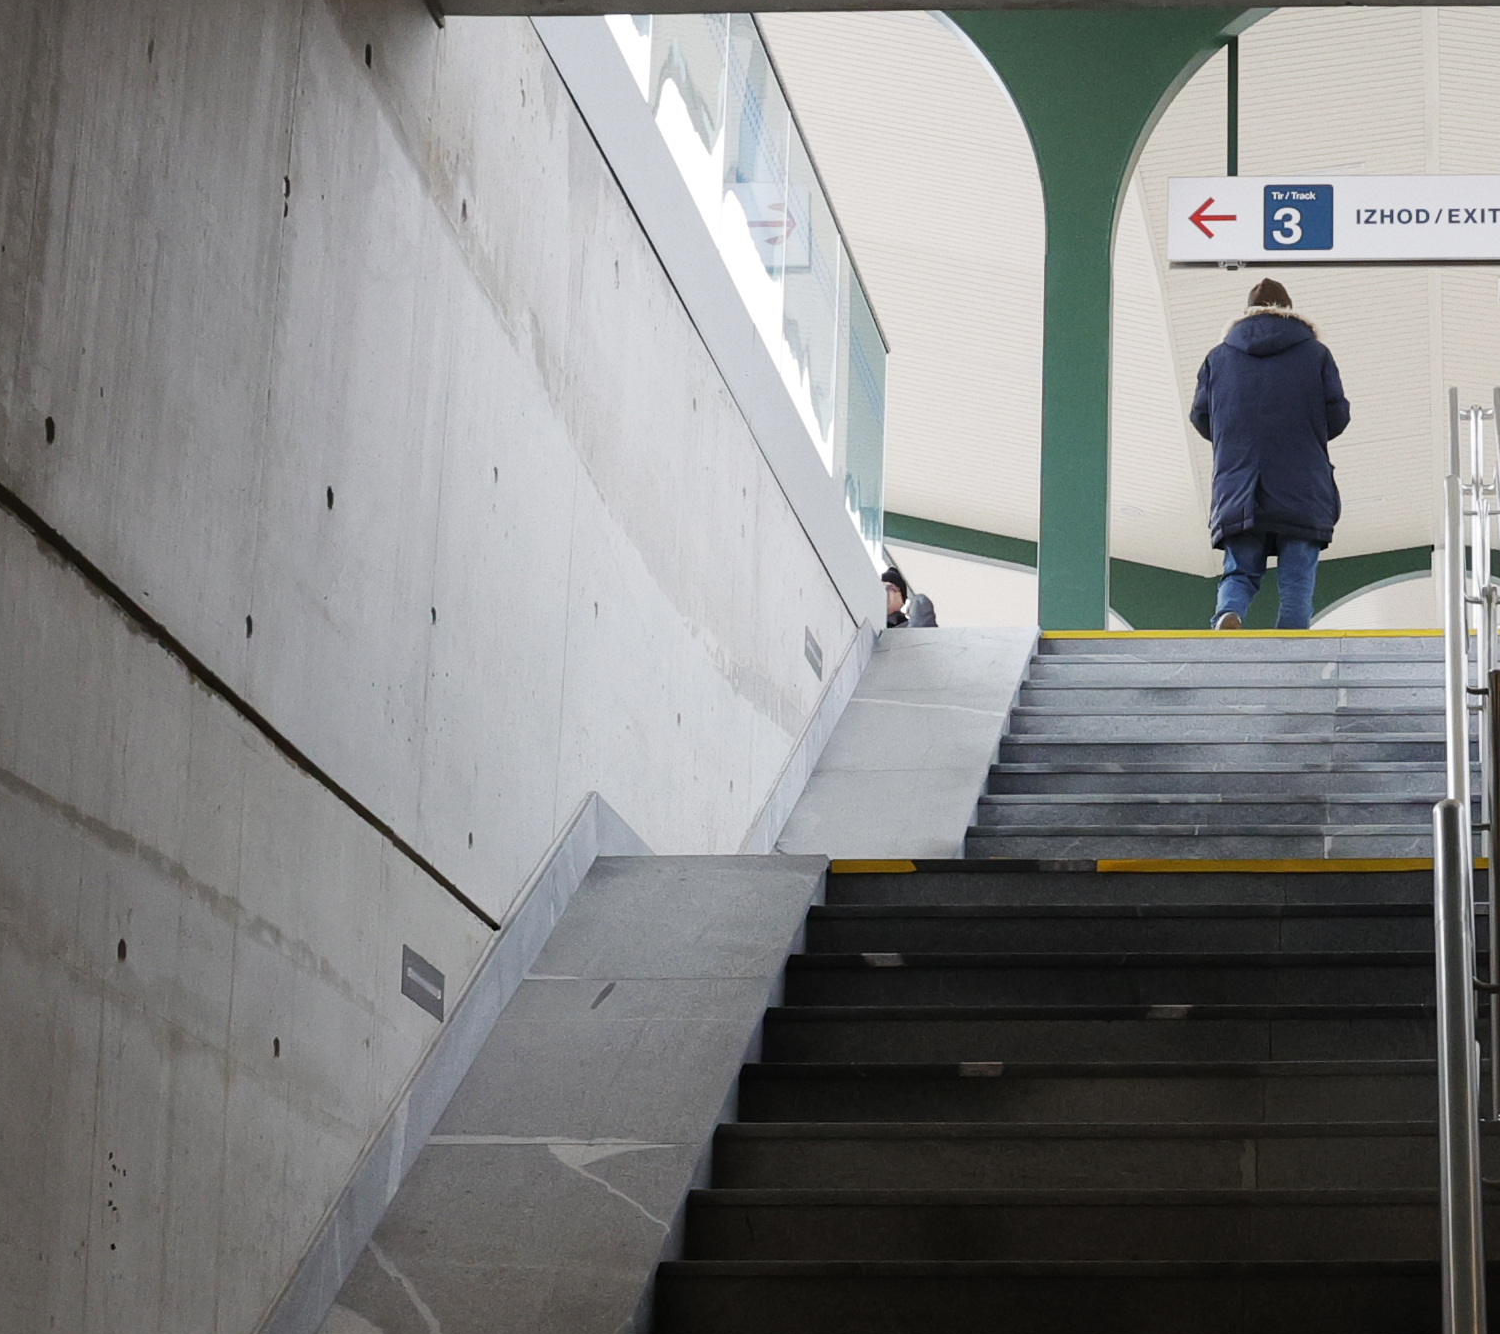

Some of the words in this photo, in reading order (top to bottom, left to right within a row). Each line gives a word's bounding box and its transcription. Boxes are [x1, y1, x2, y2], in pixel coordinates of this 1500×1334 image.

[1271, 191, 1284, 200] Tir
[1290, 191, 1316, 200] Track
[1356, 208, 1430, 225] IZHOD
[1272, 207, 1302, 245] 3
